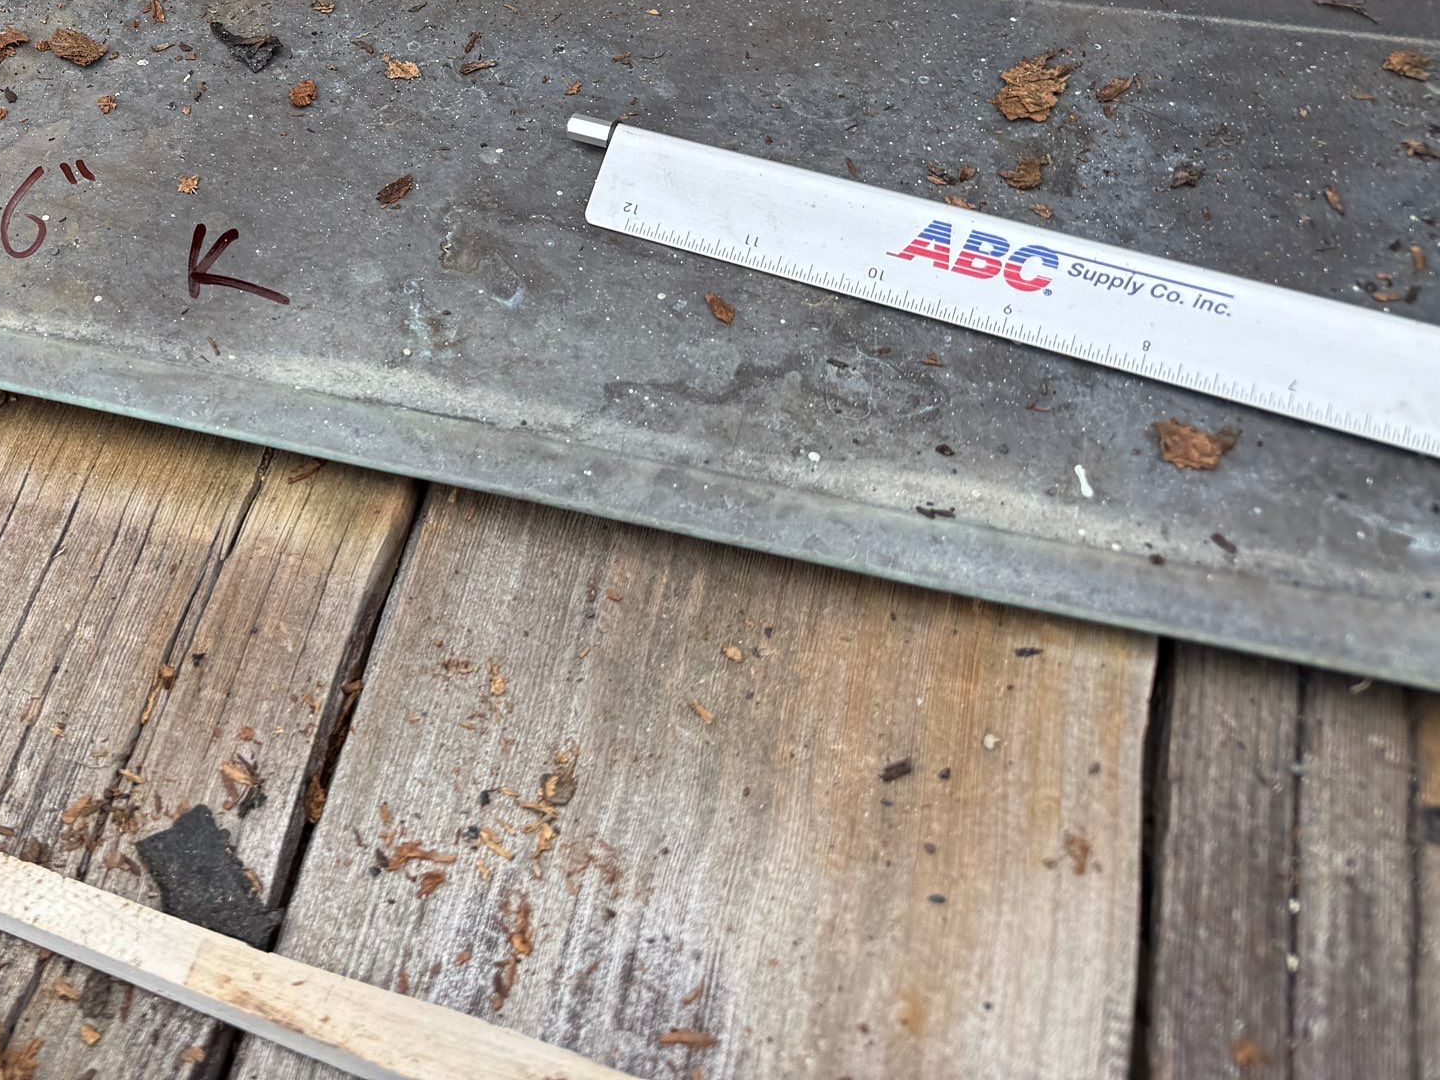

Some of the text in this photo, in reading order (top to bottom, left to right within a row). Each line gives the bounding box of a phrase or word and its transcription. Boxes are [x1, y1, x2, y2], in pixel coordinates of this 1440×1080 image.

[0, 159, 97, 259] 6"
[187, 223, 291, 306] K
[622, 200, 639, 215] 12
[744, 233, 760, 248] 11
[867, 267, 885, 282] 10
[1142, 340, 1151, 352] 8
[885, 219, 1060, 292] ABC
[1067, 262, 1145, 296] Supply
[1149, 283, 1185, 305] Co.
